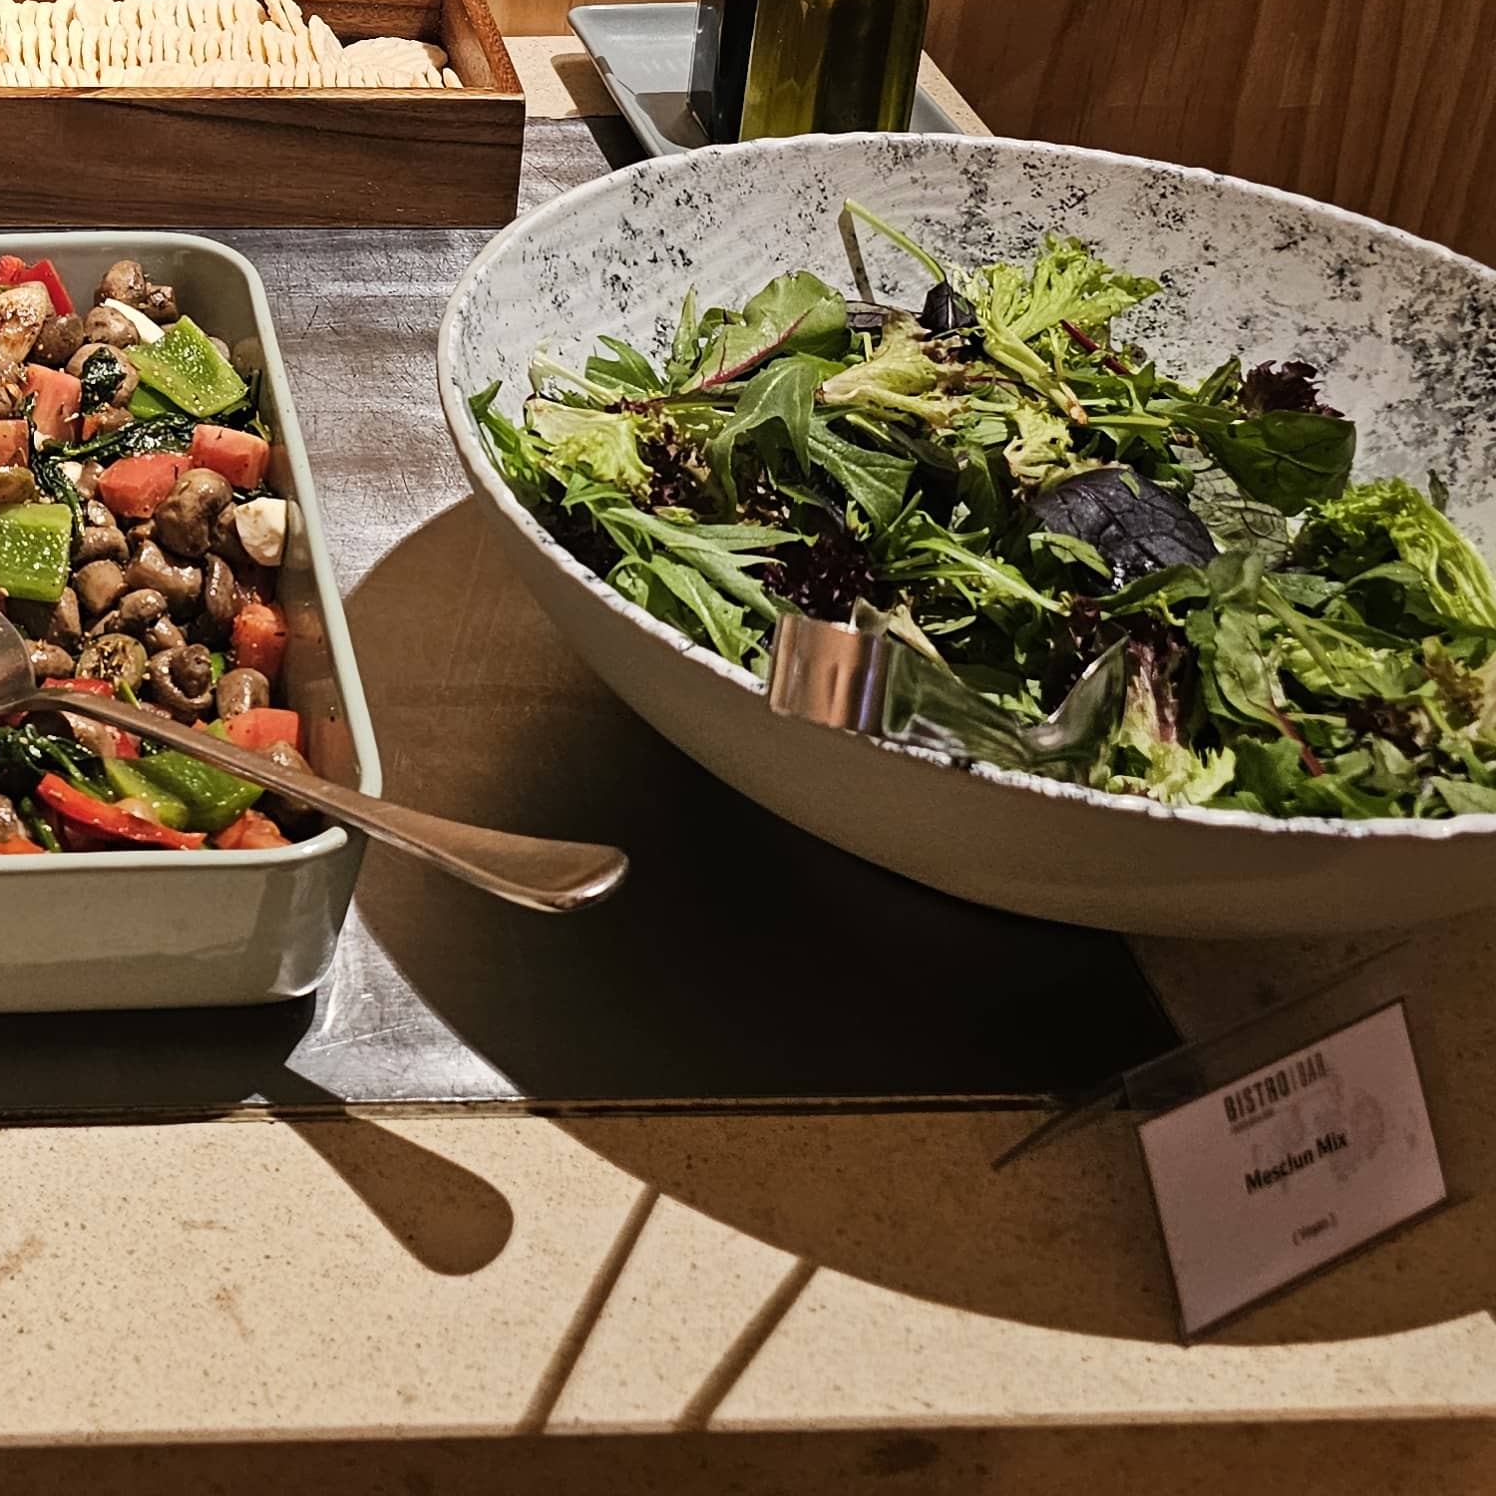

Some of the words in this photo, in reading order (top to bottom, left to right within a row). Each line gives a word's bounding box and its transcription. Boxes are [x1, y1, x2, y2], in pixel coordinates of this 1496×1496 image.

[1223, 1069, 1291, 1123] BISTRO
[1245, 1150, 1314, 1195] Mesclun
[1316, 1132, 1347, 1158] Mix
